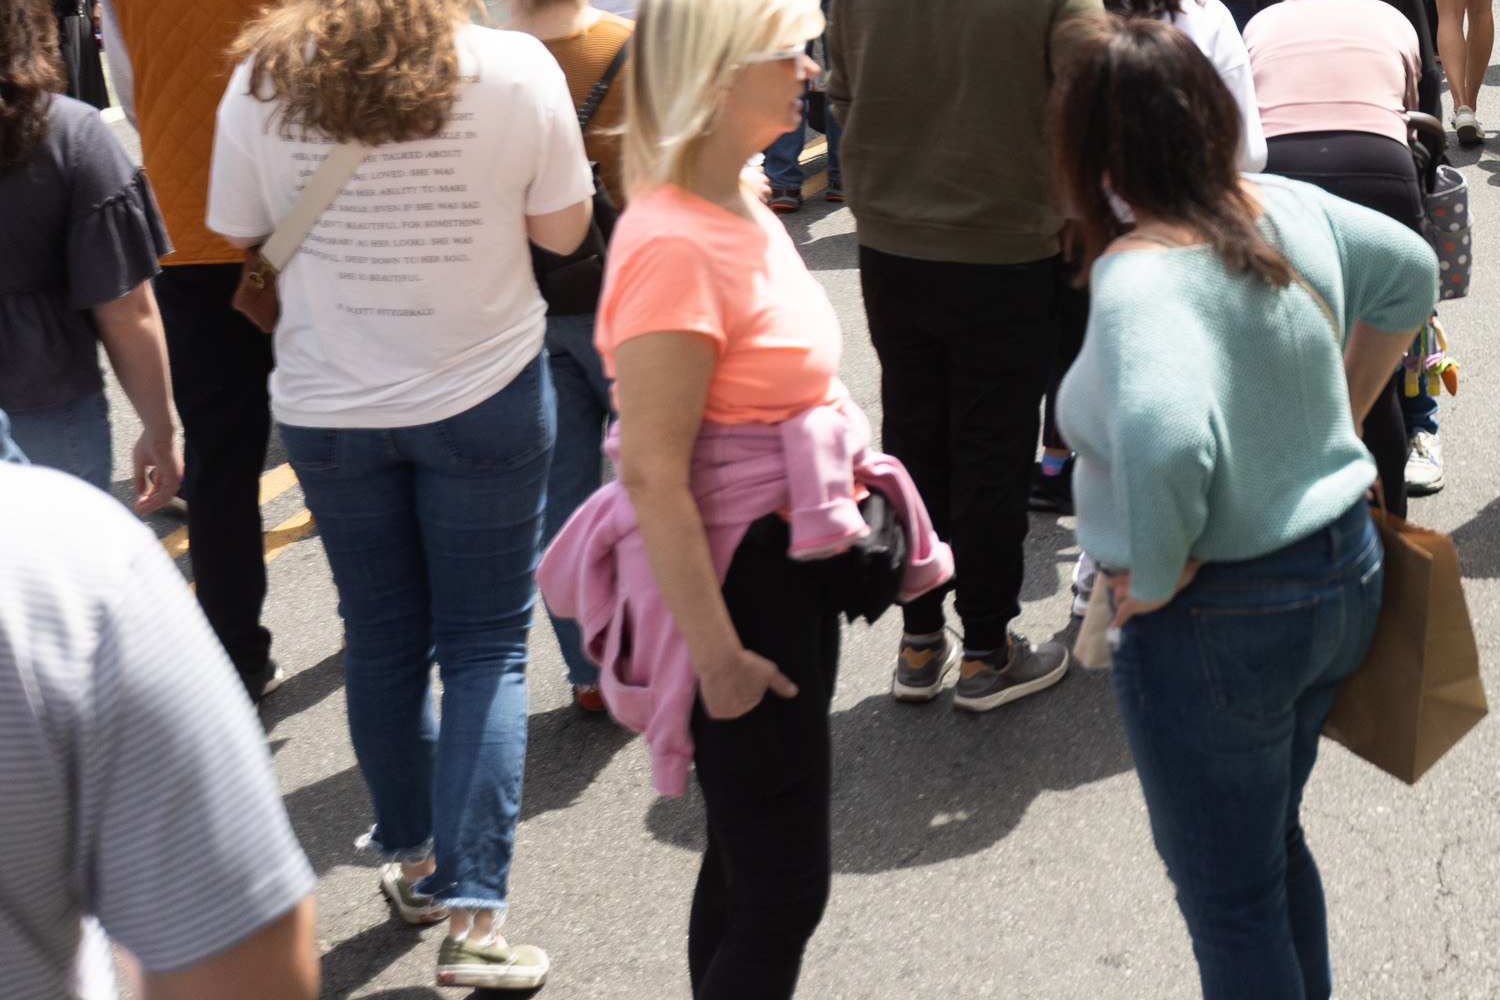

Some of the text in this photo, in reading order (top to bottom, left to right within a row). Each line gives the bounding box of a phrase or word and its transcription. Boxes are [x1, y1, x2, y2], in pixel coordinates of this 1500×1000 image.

[382, 151, 423, 161] TALKED
[426, 150, 463, 159] ABOUT
[410, 168, 430, 177] SHE
[432, 168, 454, 176] WAS
[356, 189, 376, 198] HER
[379, 186, 418, 196] ABILITY
[421, 186, 436, 194] TO
[438, 184, 468, 194] MAKE
[373, 204, 400, 212] EVEN
[402, 204, 413, 212] IF
[416, 203, 434, 211] SHE
[437, 202, 458, 210] WAS
[402, 220, 421, 229] FOR
[424, 218, 484, 228] SOMETHING
[357, 240, 368, 248] AS
[370, 240, 390, 248] HER
[430, 238, 450, 246] SHE
[452, 236, 474, 245] WAS
[344, 255, 369, 264] DEEP
[370, 256, 400, 265] DOWN
[404, 256, 418, 264] TO
[420, 255, 440, 264] HER
[338, 271, 357, 280] SHE
[359, 272, 368, 281] IS
[376, 308, 436, 317] FITZGERALD
